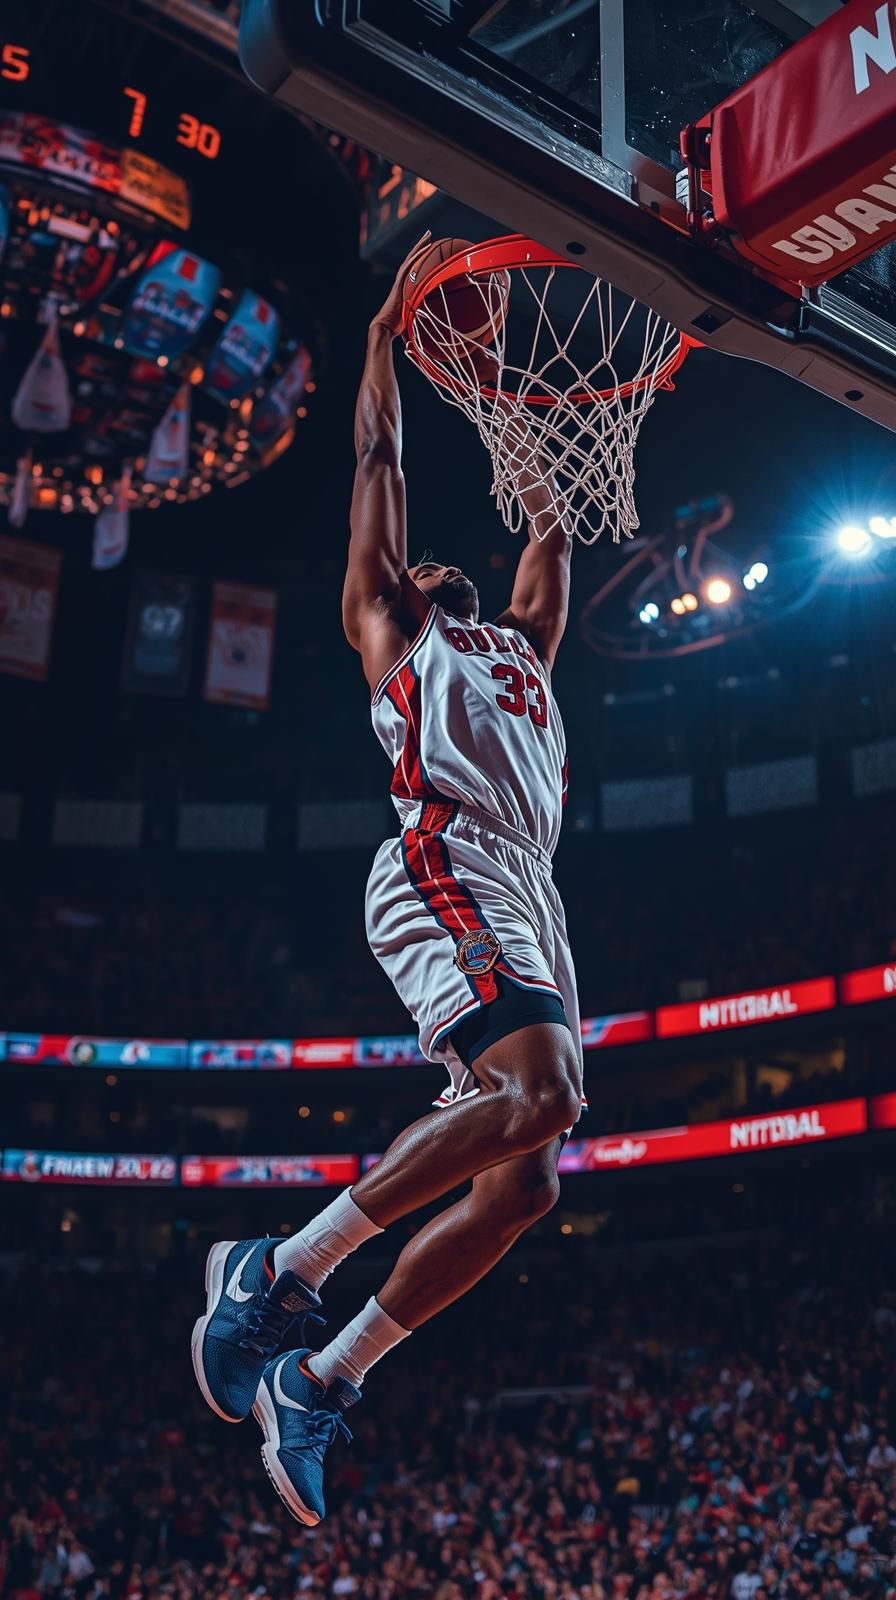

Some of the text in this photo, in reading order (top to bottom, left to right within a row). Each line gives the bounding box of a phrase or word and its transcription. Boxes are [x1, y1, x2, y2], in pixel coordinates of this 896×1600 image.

[2, 44, 30, 81] 5
[849, 2, 896, 96] N
[123, 86, 146, 138] 7
[176, 112, 221, 159] 30
[491, 662, 548, 729] 33
